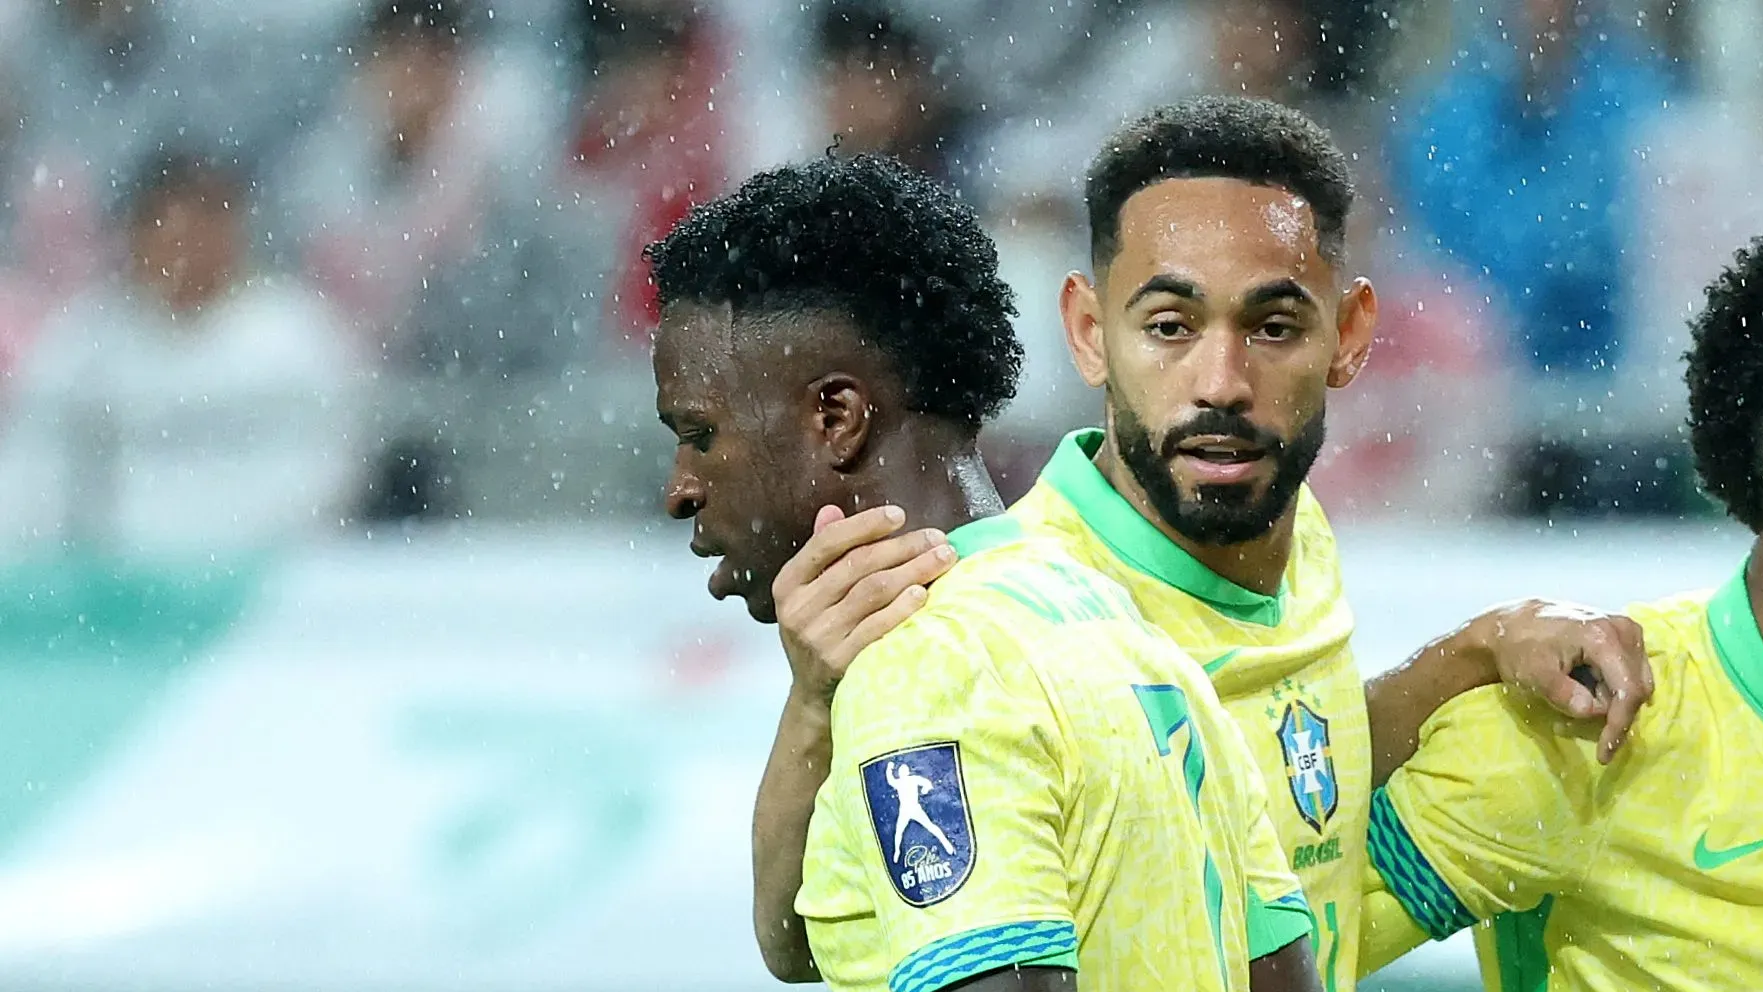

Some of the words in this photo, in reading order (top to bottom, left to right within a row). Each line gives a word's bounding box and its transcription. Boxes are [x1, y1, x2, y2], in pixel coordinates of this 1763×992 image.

[1297, 753, 1317, 771] CBF
[1293, 837, 1344, 870] BRASIL
[901, 870, 916, 890] 85
[917, 861, 952, 884] ANOS
